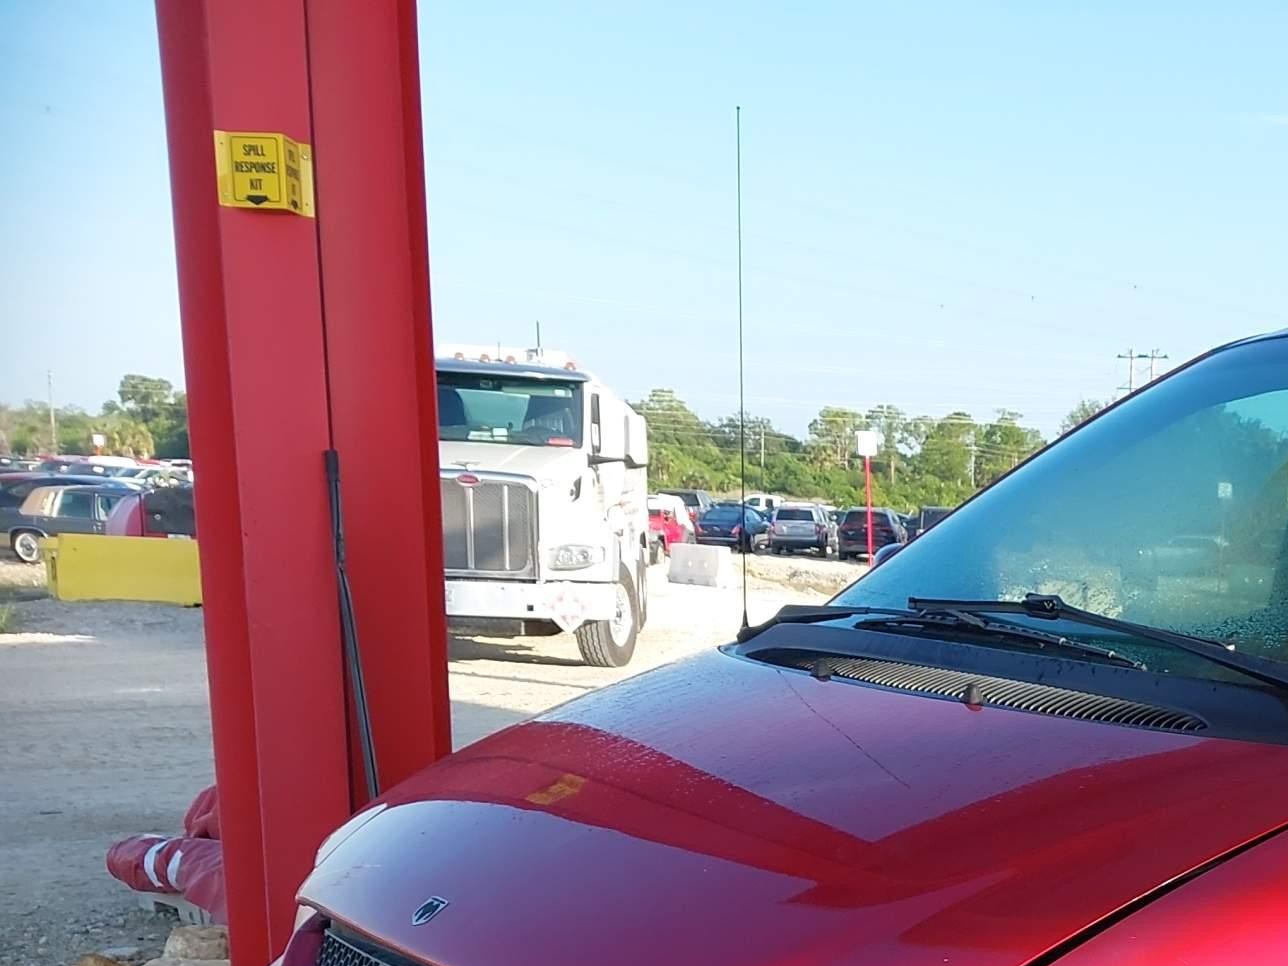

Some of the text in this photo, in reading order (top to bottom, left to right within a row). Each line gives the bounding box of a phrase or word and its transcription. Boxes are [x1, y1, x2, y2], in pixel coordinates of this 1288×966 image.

[242, 143, 266, 157] SPILL
[234, 161, 277, 174] RESPONSE
[249, 178, 263, 191] KIT
